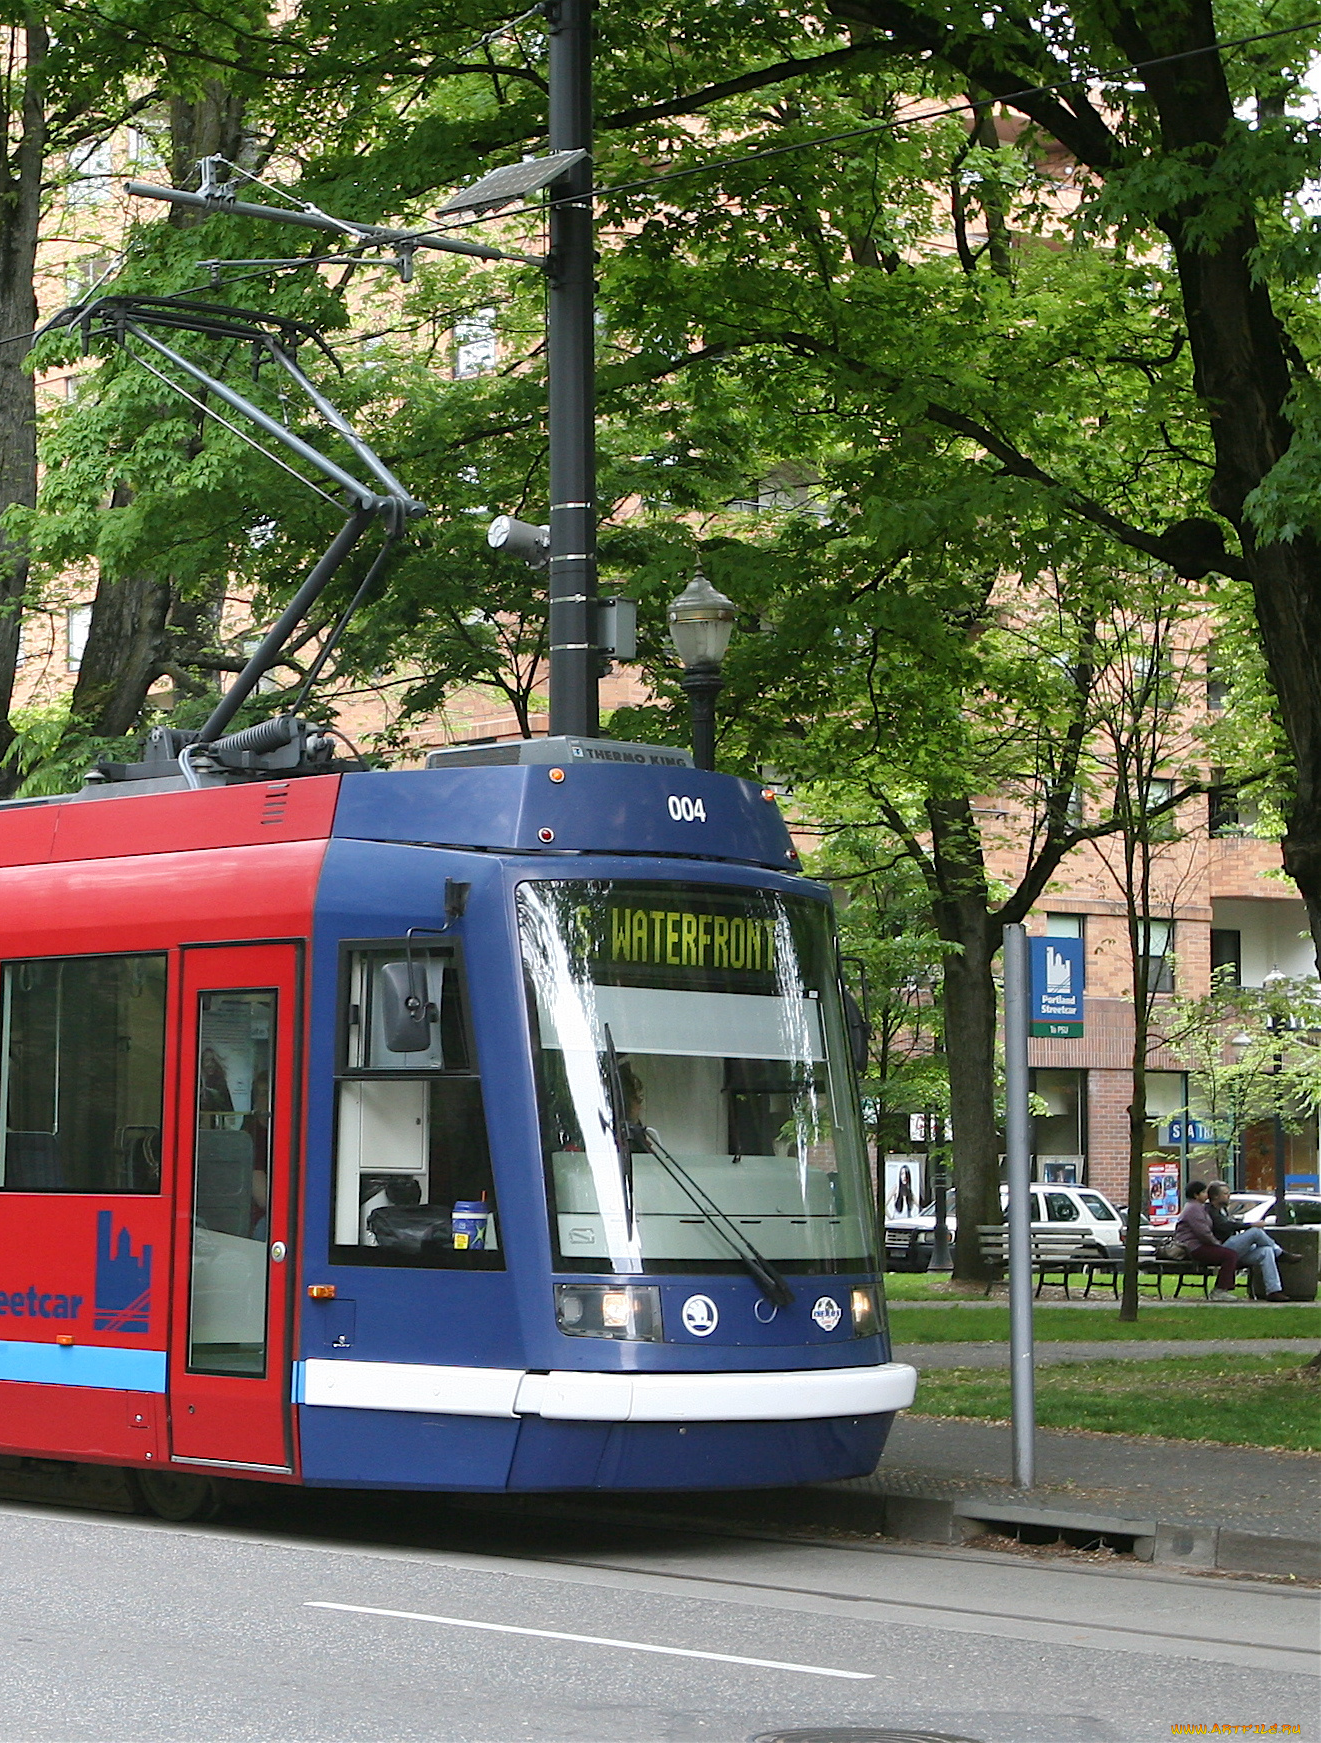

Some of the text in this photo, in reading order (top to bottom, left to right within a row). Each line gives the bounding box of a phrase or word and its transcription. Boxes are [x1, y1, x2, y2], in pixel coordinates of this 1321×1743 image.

[586, 748, 687, 767] THERMO KING
[667, 795, 707, 823] 004
[612, 907, 778, 971] WATERFRONT
[1042, 995, 1075, 1004] Portland
[1041, 1005, 1076, 1014] Streetcar
[1172, 1124, 1195, 1138] SA
